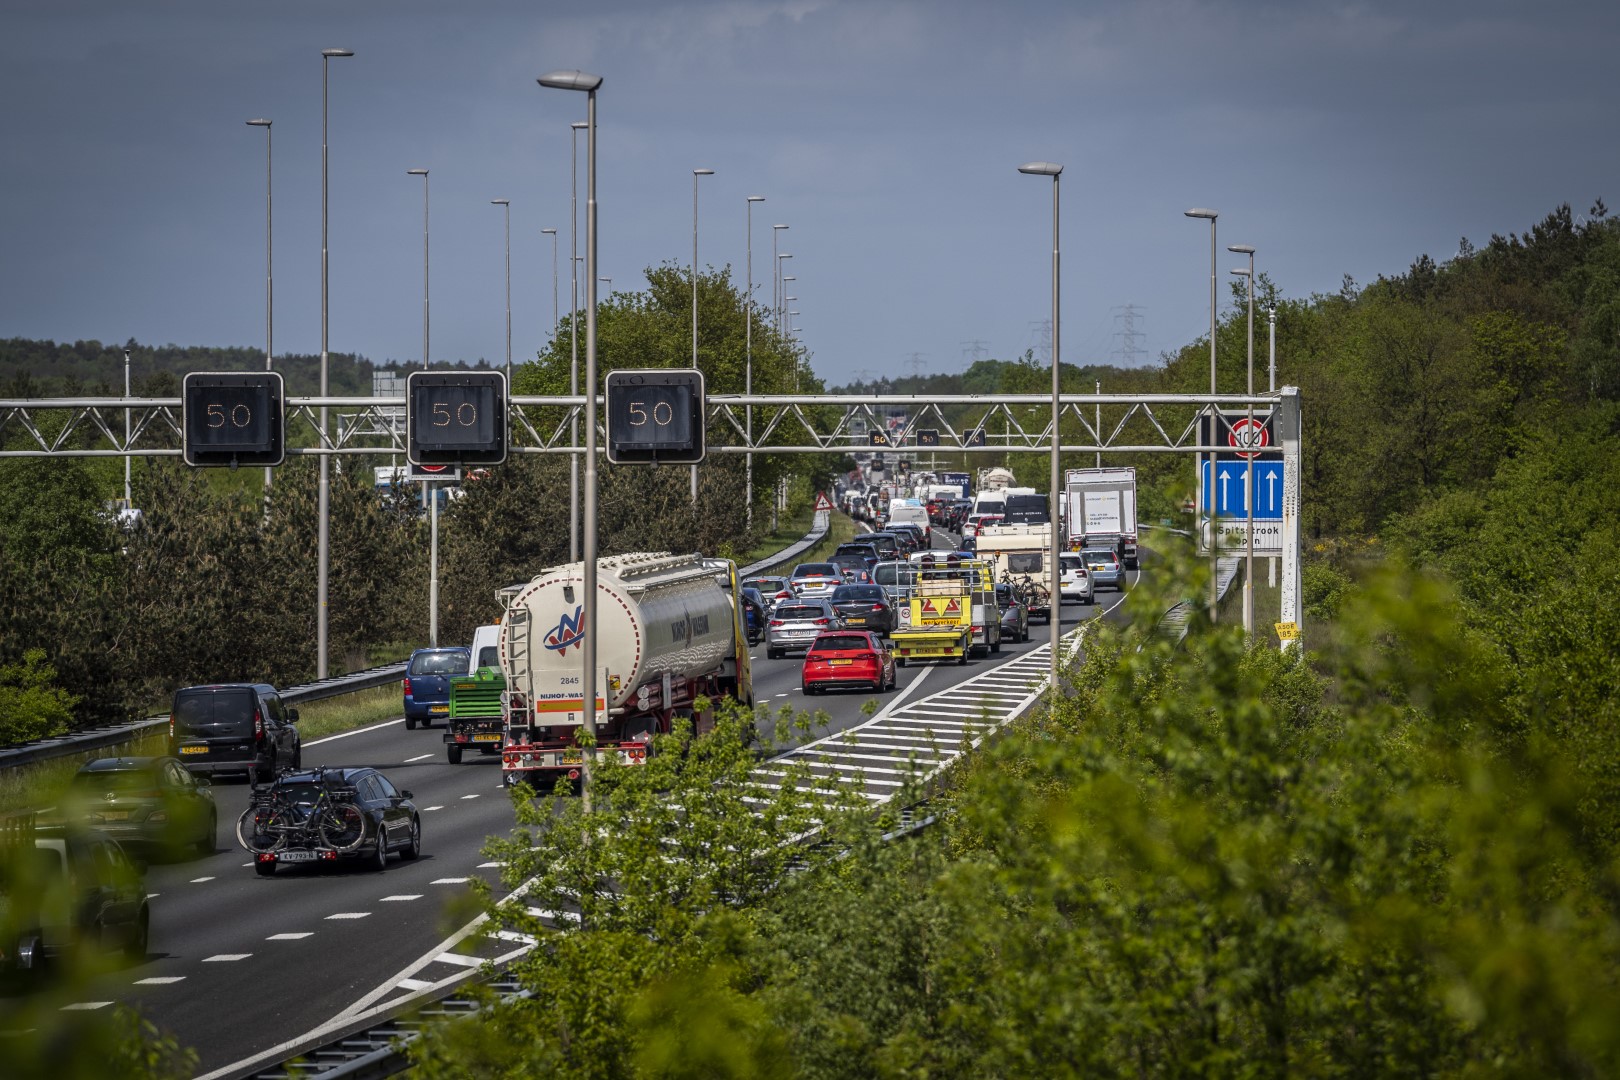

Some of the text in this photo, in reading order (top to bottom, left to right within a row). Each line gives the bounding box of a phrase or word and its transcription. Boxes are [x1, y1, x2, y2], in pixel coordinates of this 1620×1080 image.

[208, 404, 250, 427] 50
[434, 403, 476, 426] 50
[630, 402, 672, 425] 50
[560, 677, 579, 685] 2845
